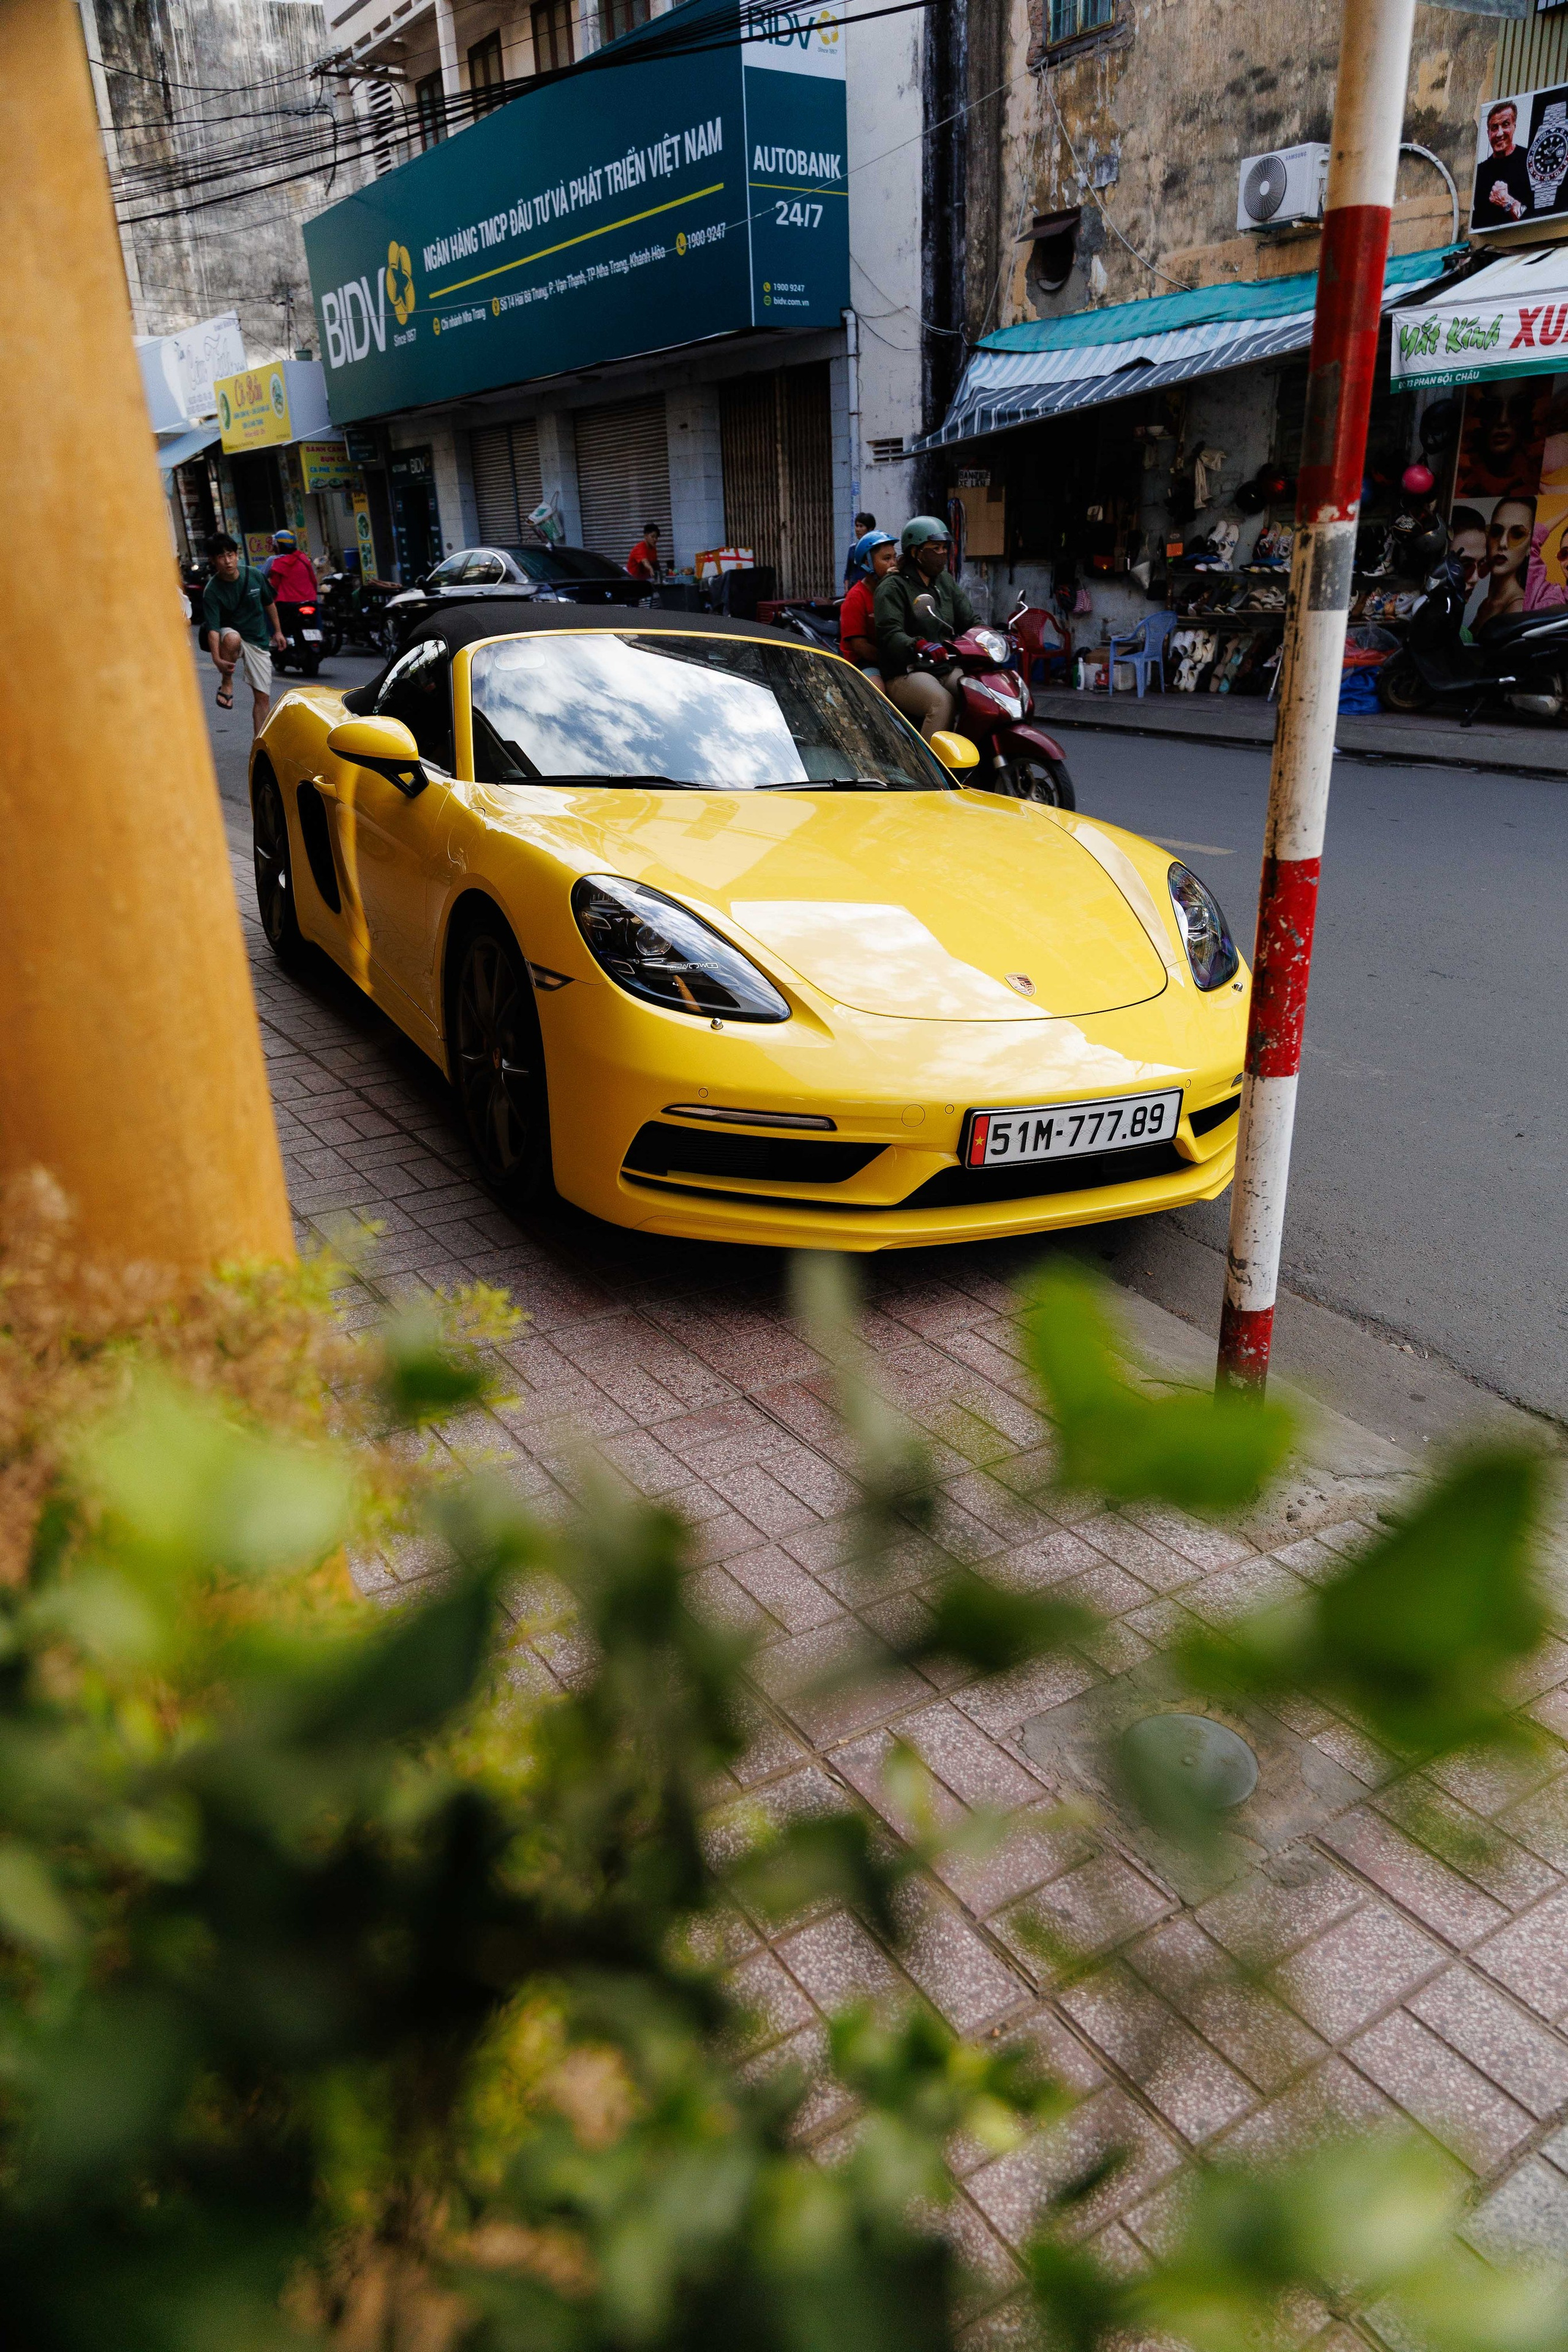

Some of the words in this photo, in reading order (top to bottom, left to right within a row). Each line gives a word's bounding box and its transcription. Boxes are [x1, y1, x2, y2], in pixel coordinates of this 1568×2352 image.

[748, 6, 815, 50] BIDV
[753, 145, 842, 179] AUTOBANK
[1286, 151, 1307, 161] SAMSUNG
[423, 237, 451, 272] NGÂN
[450, 227, 479, 261] HÀNG
[478, 213, 508, 249] TMCP
[509, 198, 533, 236] ĐẦU
[533, 189, 550, 225] TƯ
[551, 179, 570, 217] VÀ
[569, 165, 603, 211] PHÁT
[605, 146, 646, 195] TRIỂN
[647, 132, 681, 178] VIỆT
[684, 116, 723, 164] NAM
[687, 230, 706, 249] 1900
[706, 222, 726, 243] 9247
[629, 247, 651, 268] Khánh
[471, 308, 486, 320] Trang
[774, 296, 810, 306] bidv.com.vn
[322, 267, 386, 369] BIDV
[1446, 314, 1503, 354] Kính
[1509, 303, 1568, 349] XU
[394, 334, 407, 347] Since
[1414, 376, 1437, 387] PHAN
[1437, 373, 1452, 385] BỘI
[1455, 370, 1480, 382] CHÂU
[990, 1103, 1165, 1156] 51M-777.89
